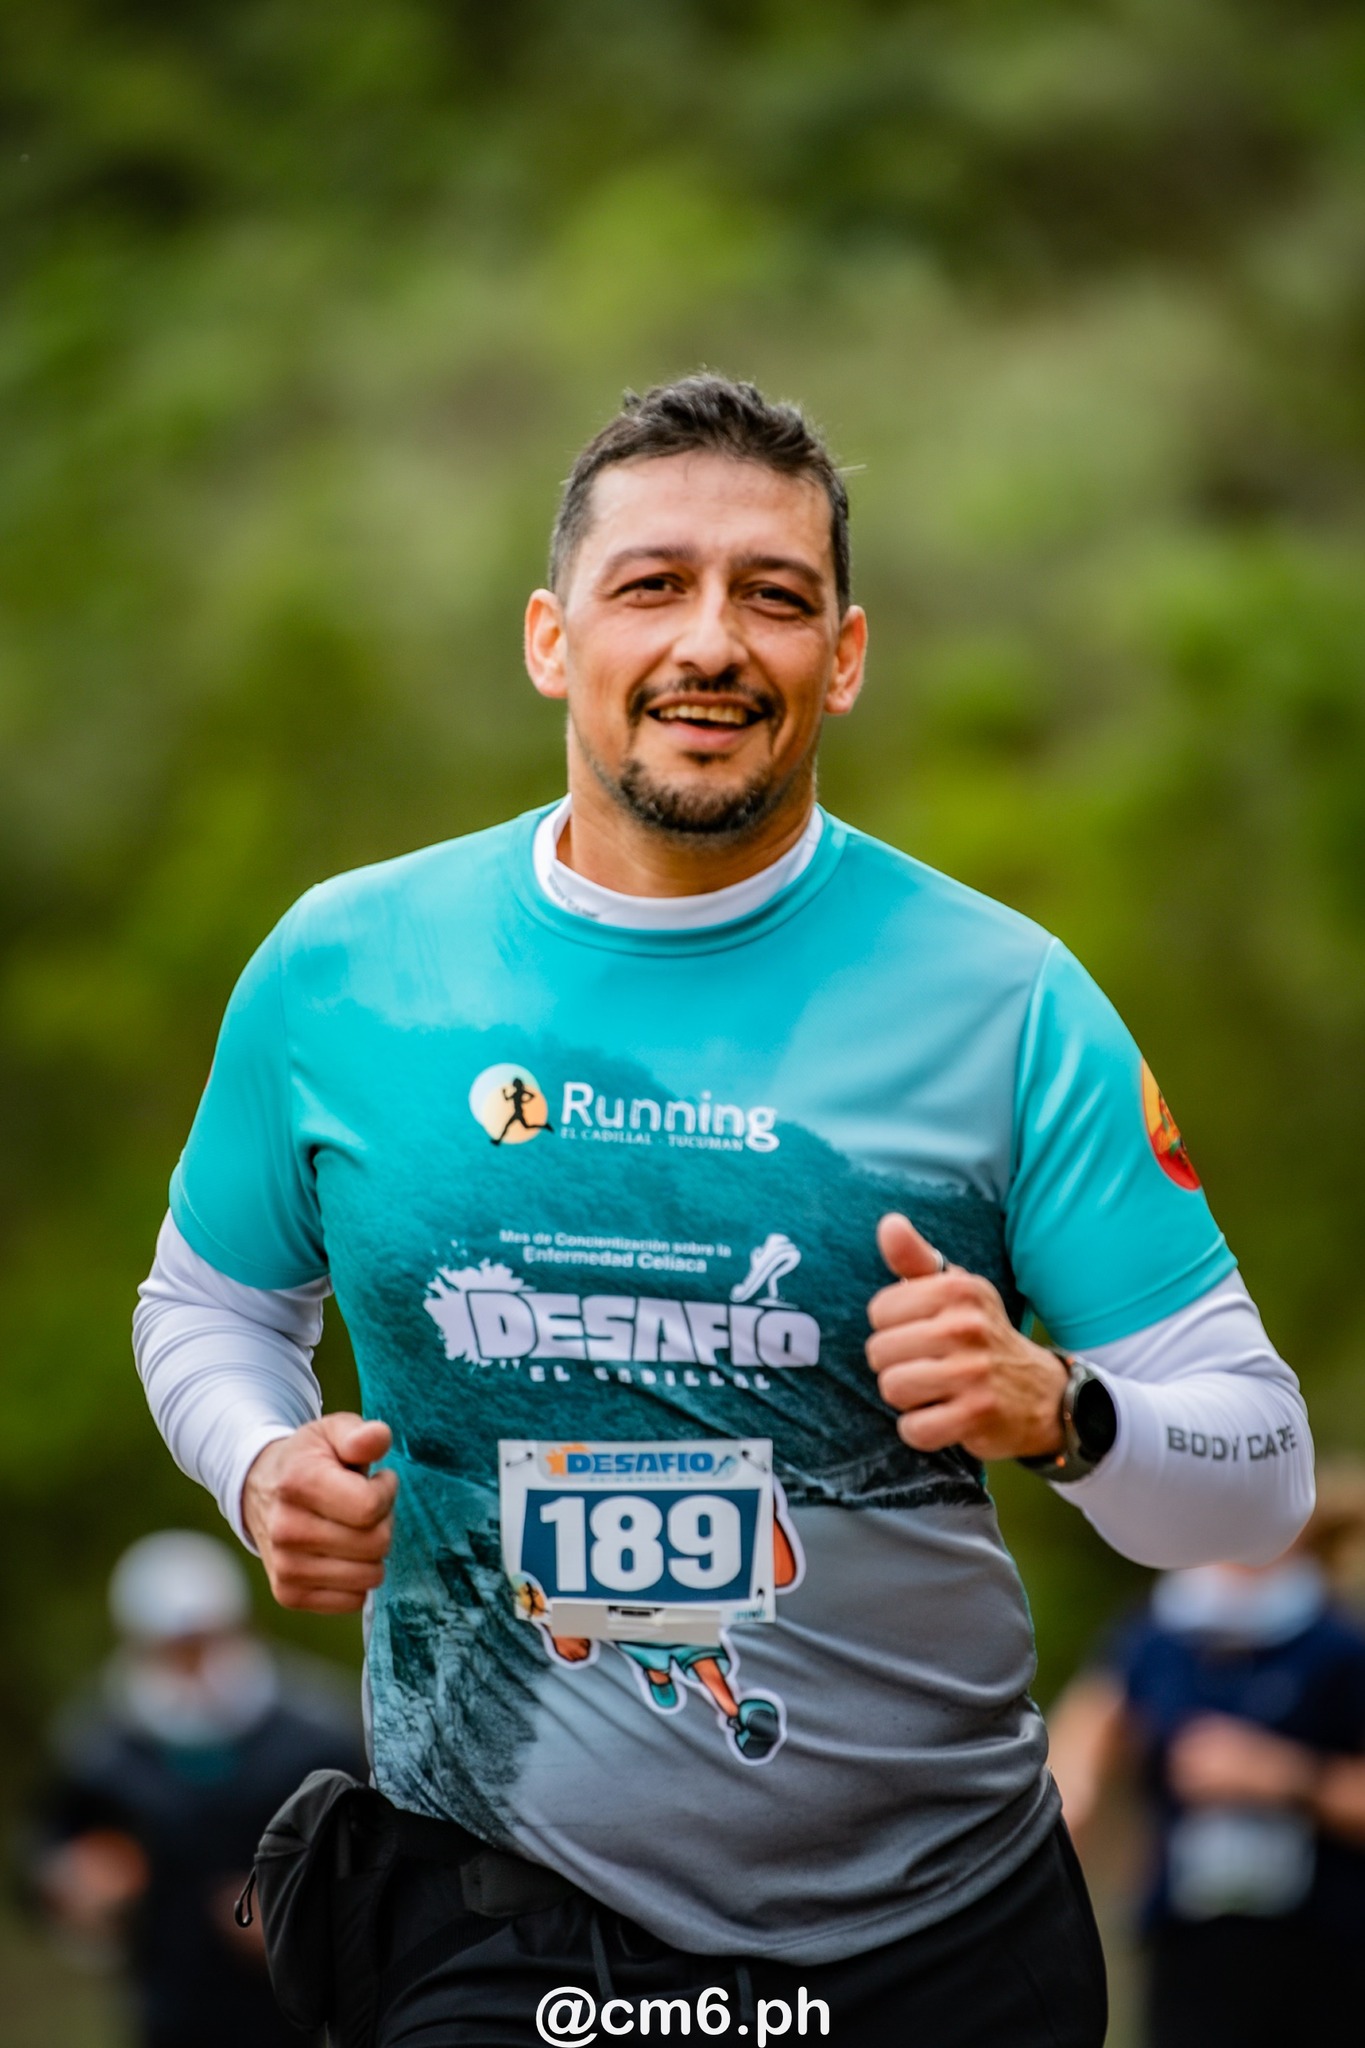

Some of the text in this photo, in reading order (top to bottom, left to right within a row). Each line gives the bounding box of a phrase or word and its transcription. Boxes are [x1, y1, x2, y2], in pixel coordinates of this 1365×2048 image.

[559, 1080, 780, 1153] Running
[560, 1126, 577, 1141] EL
[580, 1128, 653, 1147] CADILLAL
[499, 1229, 530, 1245] Mes
[532, 1232, 552, 1246] de
[671, 1241, 715, 1257] sobre
[716, 1243, 732, 1259] la
[523, 1245, 634, 1268] Enfermedad
[529, 1365, 570, 1382] EL
[1166, 1426, 1240, 1462] BODY
[539, 1494, 742, 1592] 189
